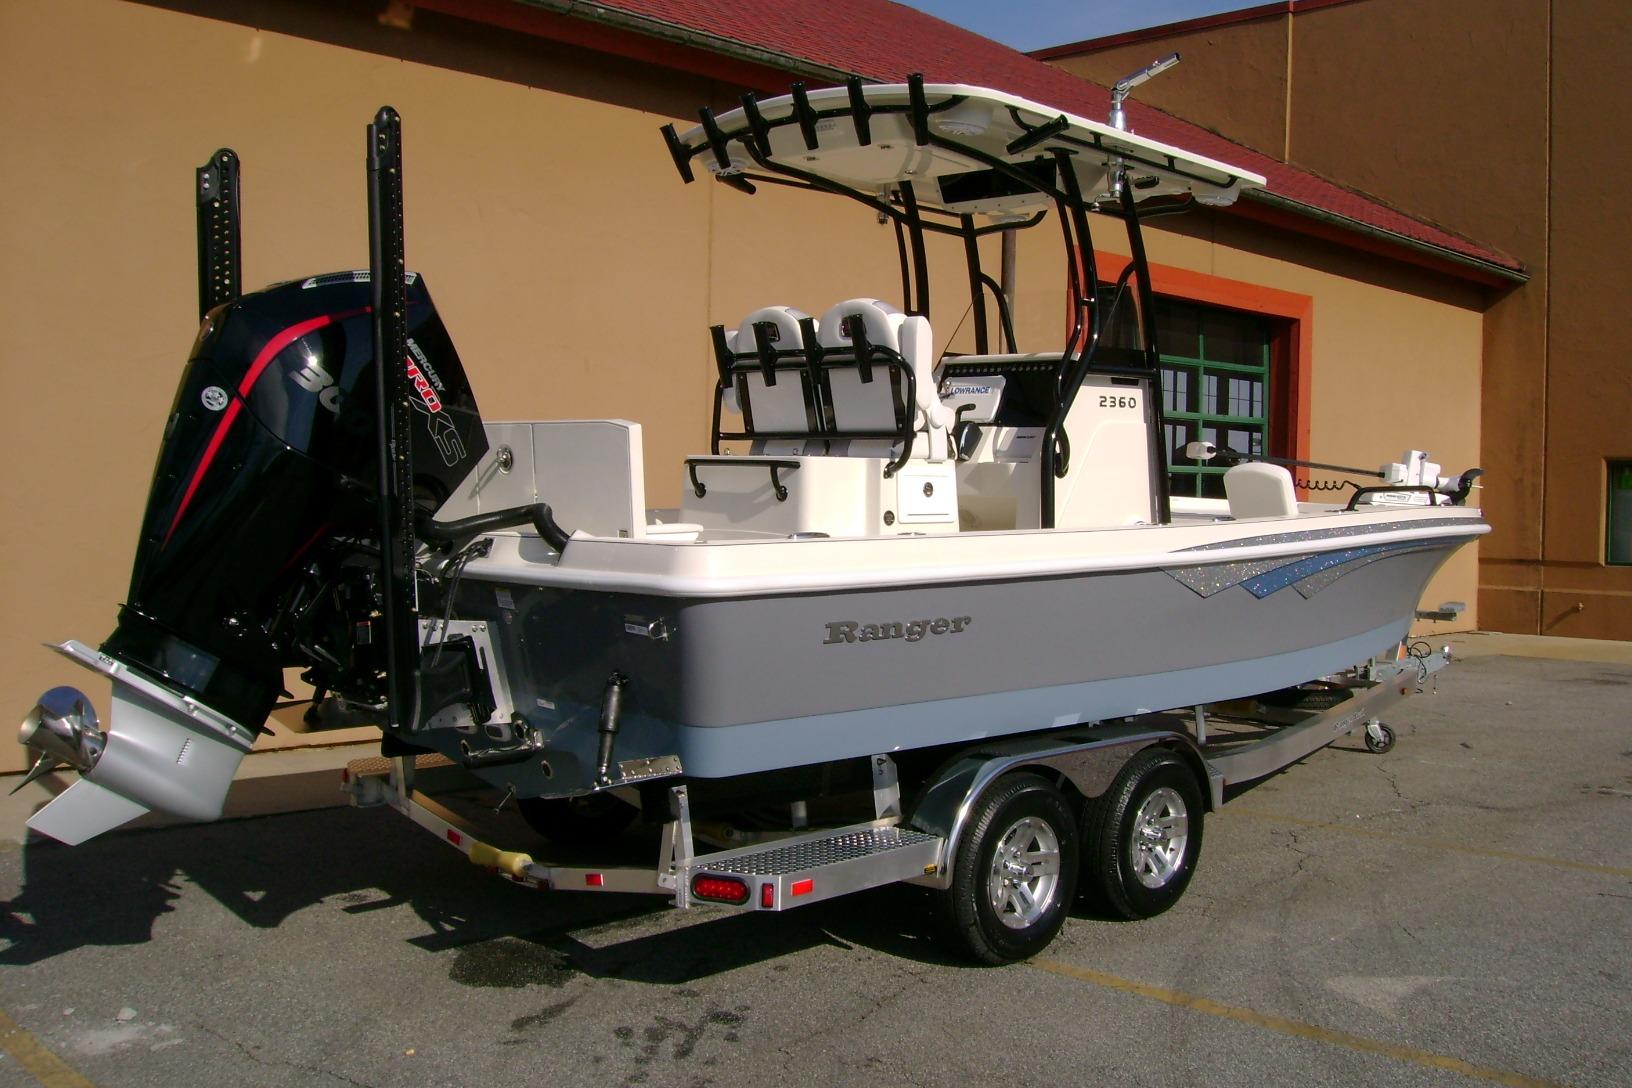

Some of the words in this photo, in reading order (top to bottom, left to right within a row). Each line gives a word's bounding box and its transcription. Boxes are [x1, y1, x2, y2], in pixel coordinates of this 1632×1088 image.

[406, 338, 446, 392] MERCURY
[406, 355, 442, 413] RO
[950, 385, 992, 396] LOWRANCE
[1099, 395, 1137, 409] 2360
[408, 395, 467, 467] XS
[823, 615, 972, 645] Ranger
